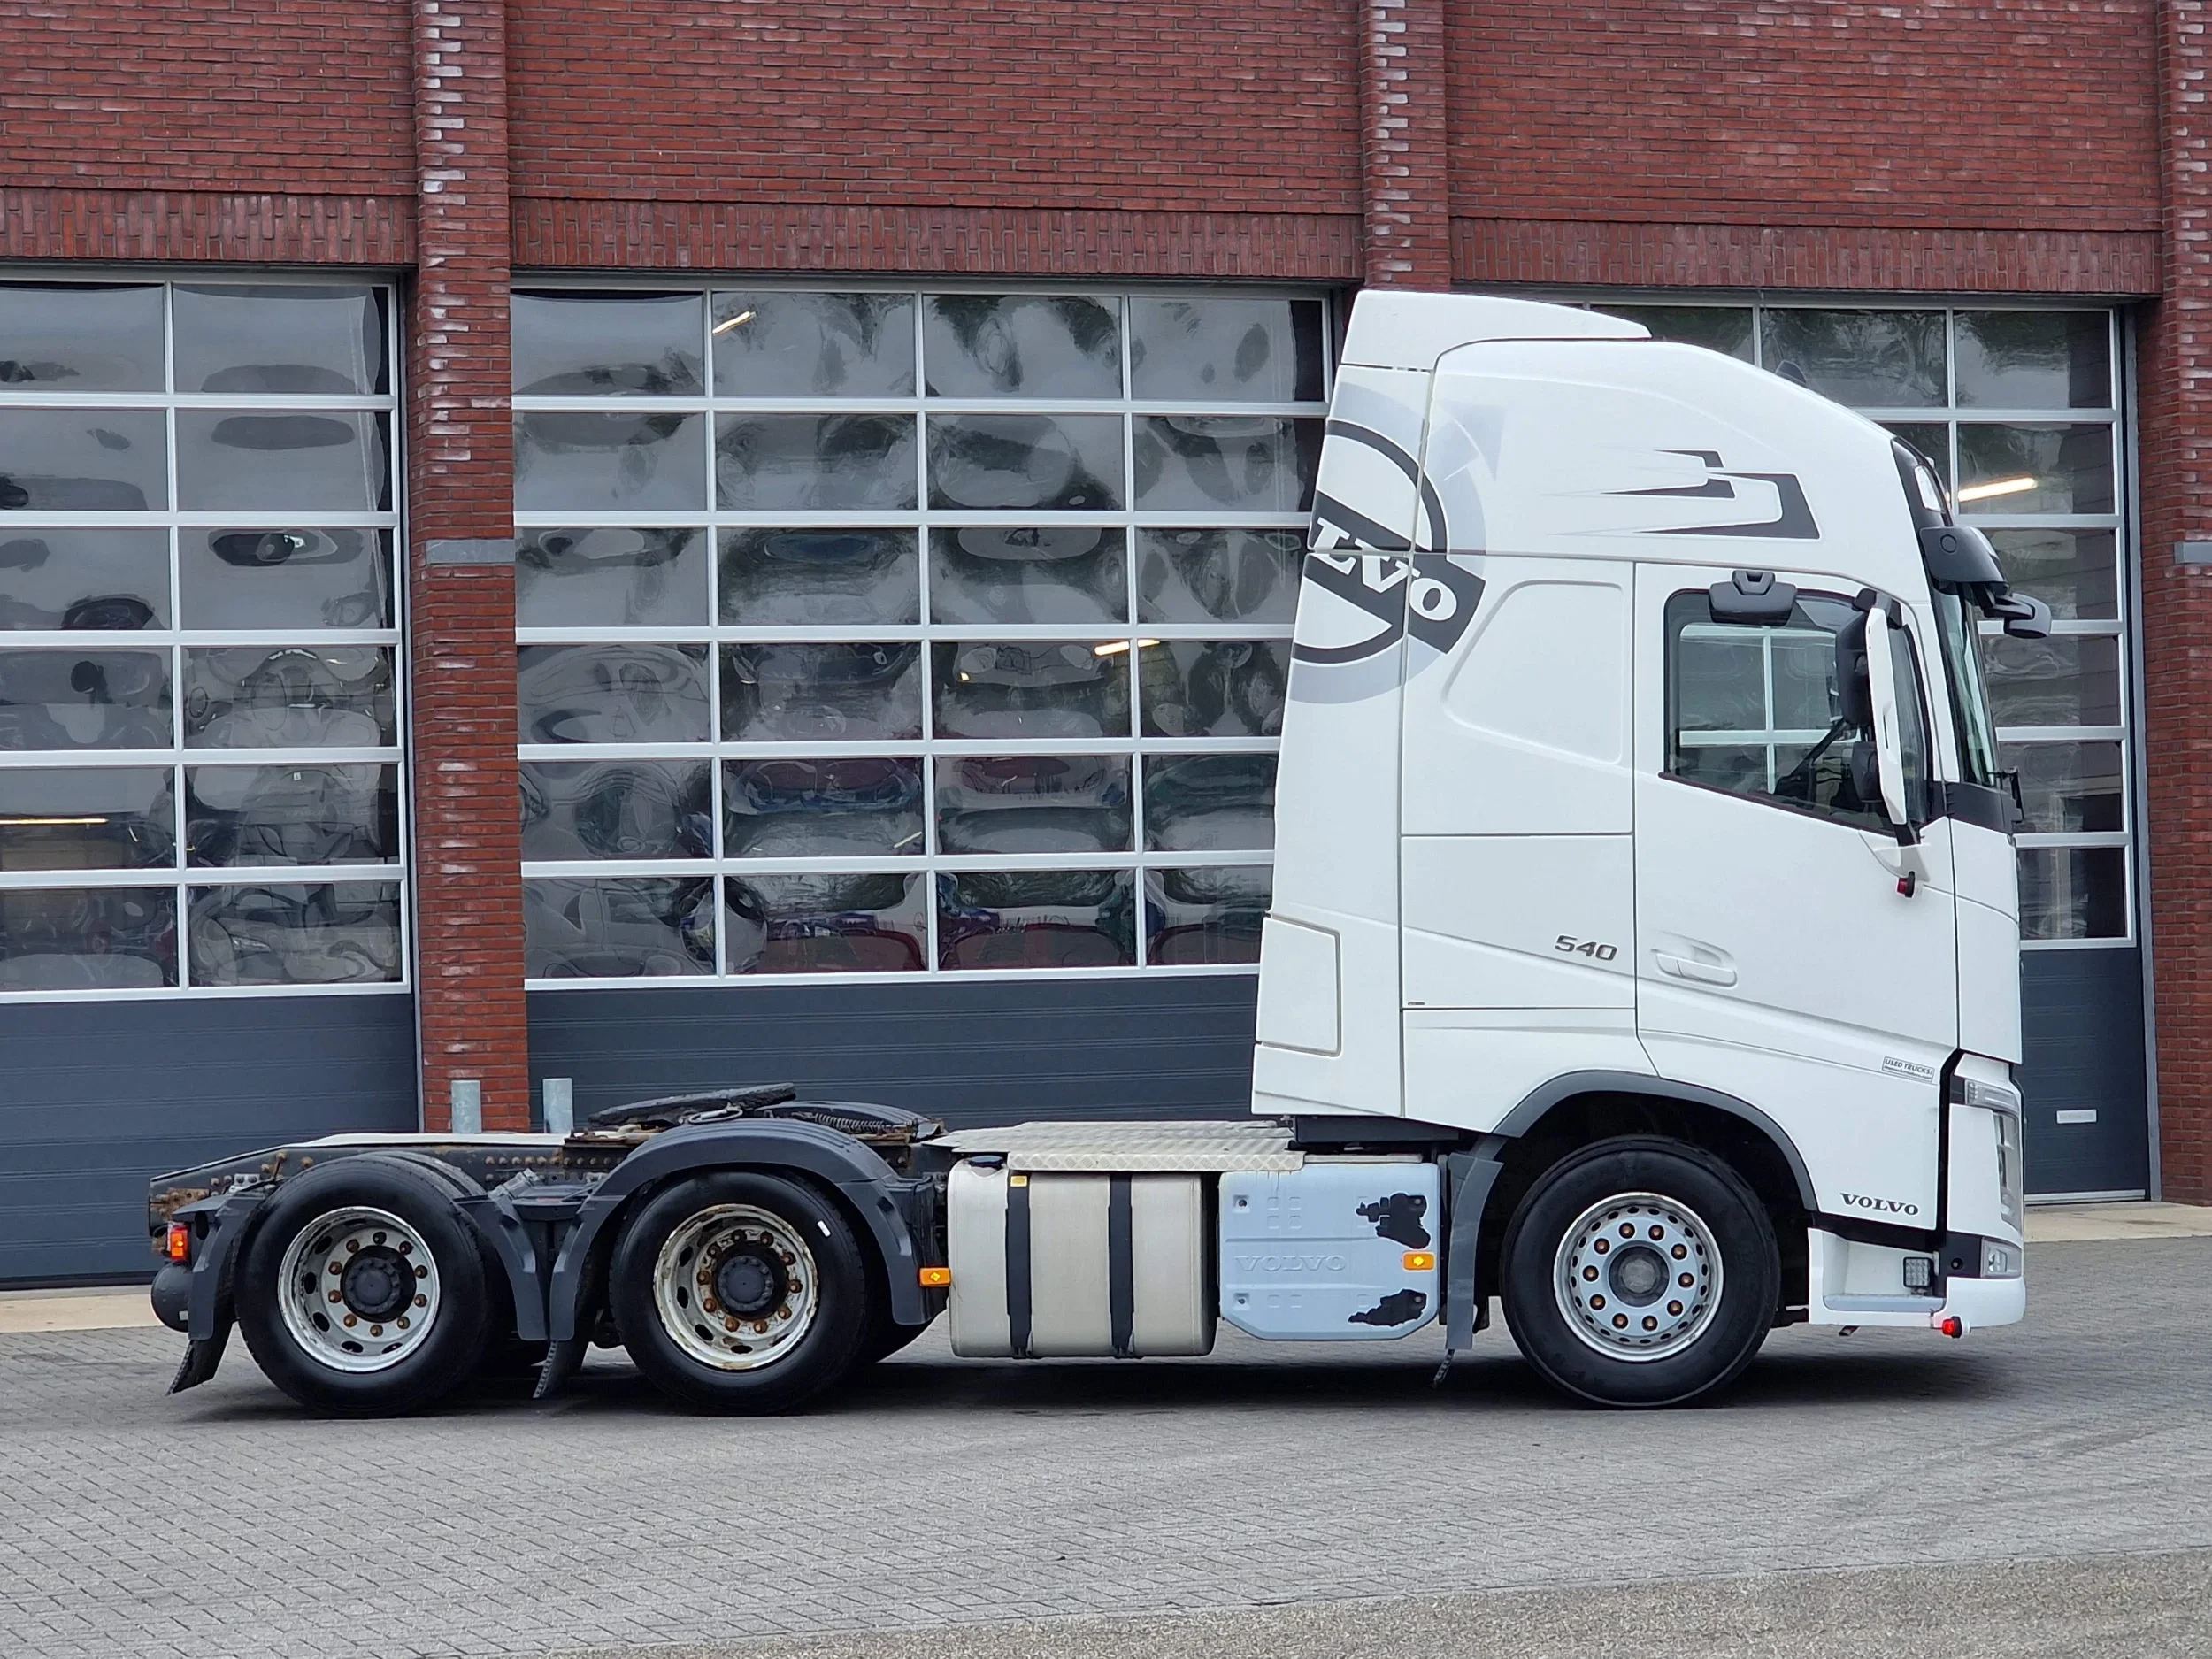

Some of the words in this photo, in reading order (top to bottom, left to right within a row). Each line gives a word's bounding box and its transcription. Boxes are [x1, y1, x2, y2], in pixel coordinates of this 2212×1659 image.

[1555, 934, 1617, 961] 540
[1885, 1058, 1903, 1068] USED
[1839, 1192, 1919, 1216] VOLVO
[1234, 1255, 1347, 1272] VOLVO
